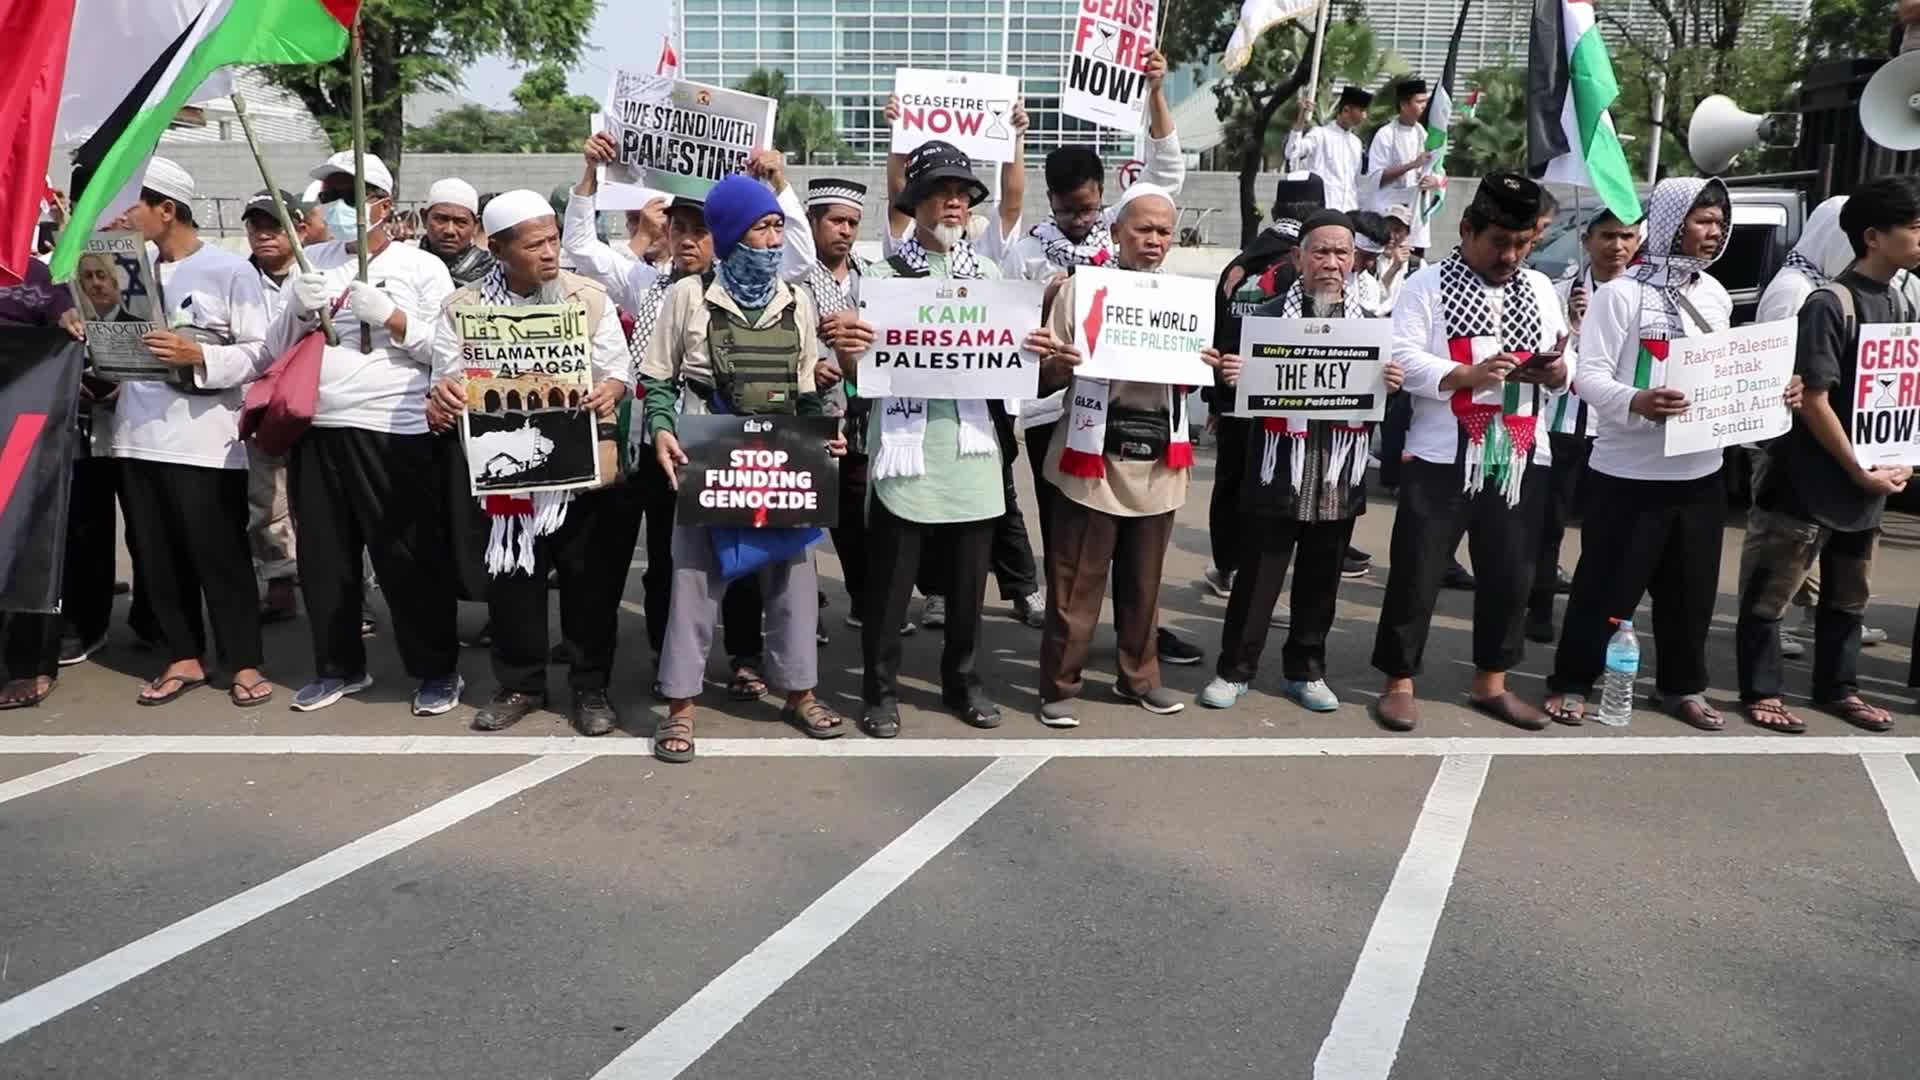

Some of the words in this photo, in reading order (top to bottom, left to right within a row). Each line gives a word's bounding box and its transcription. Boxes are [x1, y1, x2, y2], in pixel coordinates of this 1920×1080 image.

[1069, 54, 1146, 104] NOW!
[902, 94, 984, 110] CEASEFIRE
[623, 100, 650, 126] WE
[653, 106, 707, 137] STAND
[711, 116, 755, 146] WITH
[903, 108, 984, 136] NOW
[622, 129, 748, 181] PALESTINE
[107, 239, 136, 250] FOR
[918, 305, 987, 323] KAMI
[1106, 305, 1144, 326] FREE
[1149, 309, 1198, 332] WORLD
[886, 329, 1014, 346] BERSAMA
[1105, 328, 1137, 346] FREE
[1140, 331, 1206, 353] PALESTINE
[463, 344, 585, 360] SELAMATKAN
[875, 352, 1022, 369] PALESTINA
[1263, 346, 1291, 357] Unity
[1293, 347, 1306, 356] Of
[1308, 348, 1326, 356] The
[1328, 349, 1369, 357] Moslem
[1275, 364, 1307, 390] THE
[1314, 362, 1351, 389] KEY
[1714, 358, 1762, 378] Berhak
[1263, 397, 1277, 406] To
[1278, 397, 1303, 406] Free
[1304, 396, 1359, 406] Palestine
[1693, 384, 1732, 402] Hidup
[1074, 395, 1103, 411] GAZA
[1712, 417, 1764, 437] Sendiri
[729, 450, 788, 468] STOP
[705, 470, 812, 488] FUNDING
[699, 491, 817, 509] GENOCIDE
